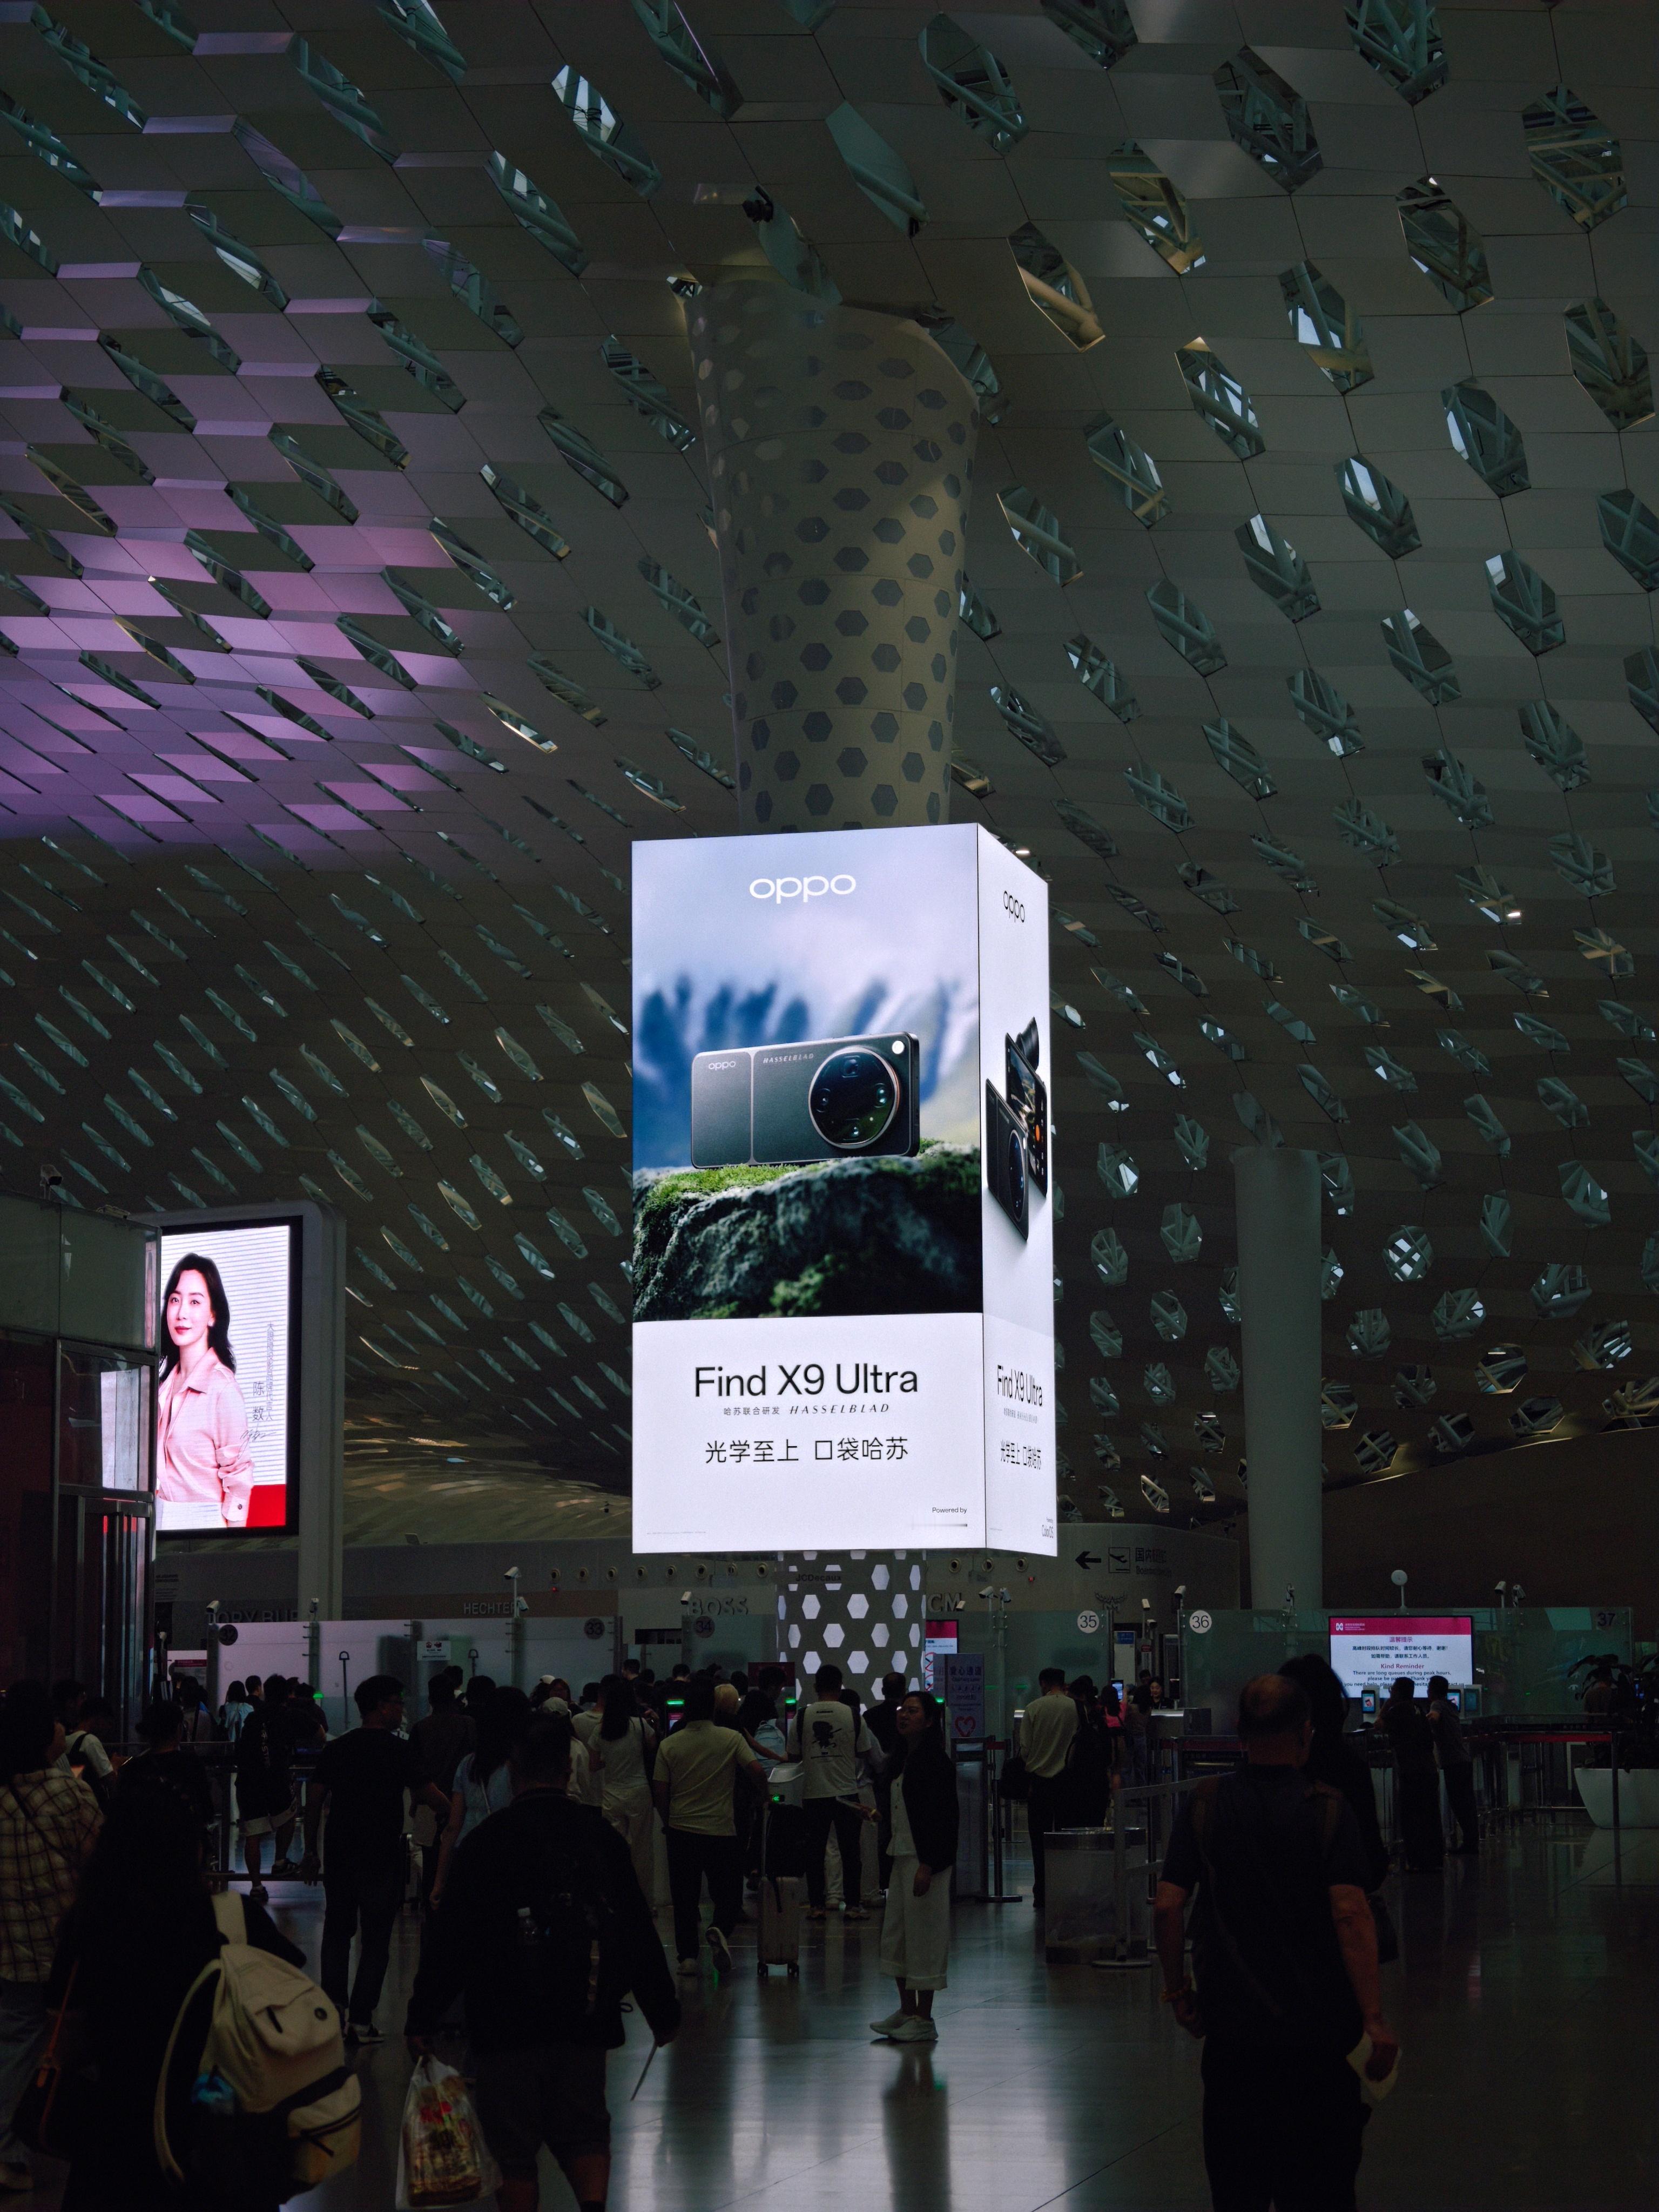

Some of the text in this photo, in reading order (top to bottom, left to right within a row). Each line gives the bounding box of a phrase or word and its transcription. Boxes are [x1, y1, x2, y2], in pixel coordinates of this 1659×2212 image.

[749, 874, 857, 904] oppo
[1003, 891, 1025, 923] oppo
[709, 1060, 736, 1070] oppo
[763, 1053, 814, 1064] HASSELBLAD
[695, 1363, 918, 1397] Find X9 Ultra
[997, 1365, 1042, 1407] Find X9 Ultra
[724, 1404, 889, 1415] 哈苏联合研发 HASSELBLAD
[705, 1437, 908, 1464] 光学至上 口袋哈苏
[1001, 1439, 1020, 1464] 光学至上
[795, 1574, 842, 1582] JCDecaux
[690, 1597, 748, 1615] BOSS
[696, 1620, 712, 1634] 34
[1080, 1615, 1097, 1628] 35
[1192, 1615, 1209, 1628] 36
[1598, 1613, 1616, 1627] 37
[585, 1622, 603, 1635] 33
